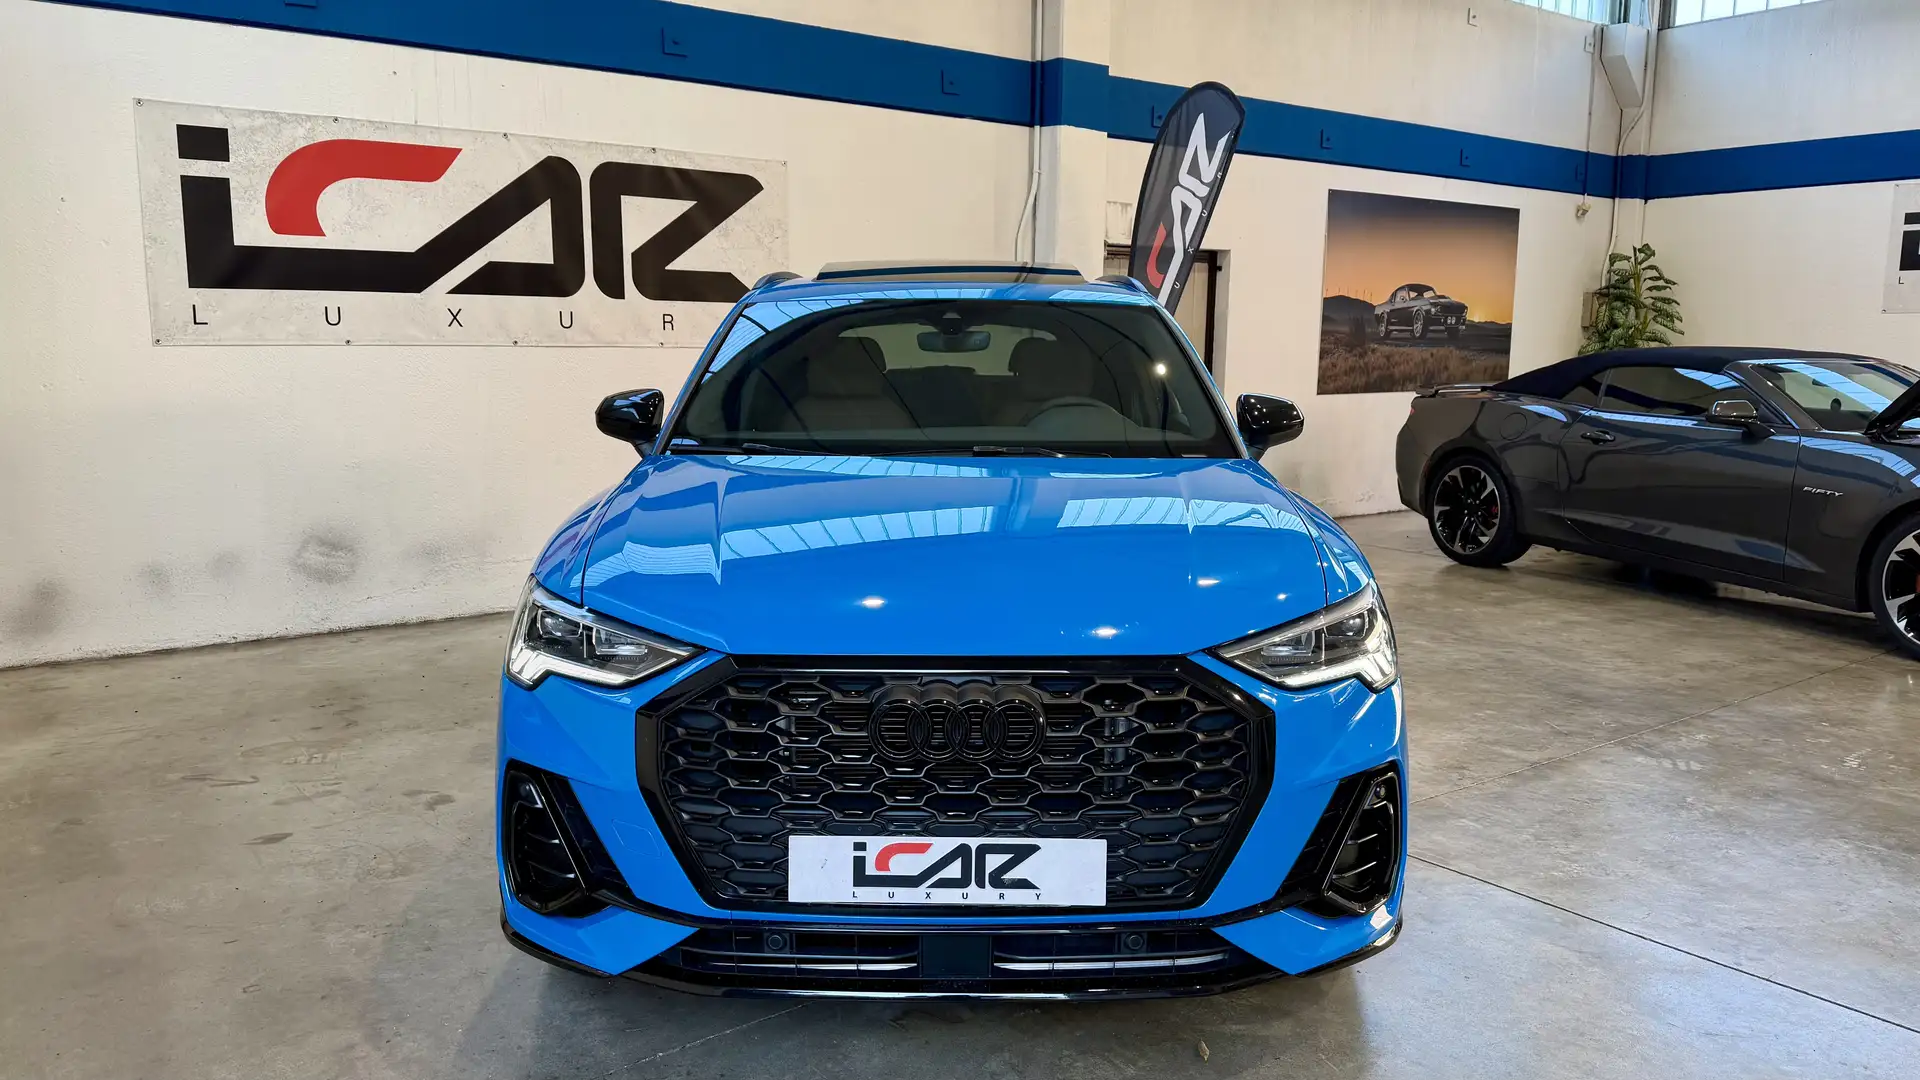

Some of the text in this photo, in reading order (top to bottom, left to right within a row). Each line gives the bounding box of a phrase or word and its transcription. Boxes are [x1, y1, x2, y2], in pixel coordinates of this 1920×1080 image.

[1146, 112, 1231, 307] CAR
[192, 304, 674, 331] LUXUR
[1803, 486, 1843, 496] FIFTY
[852, 890, 1041, 900] LUXURY
